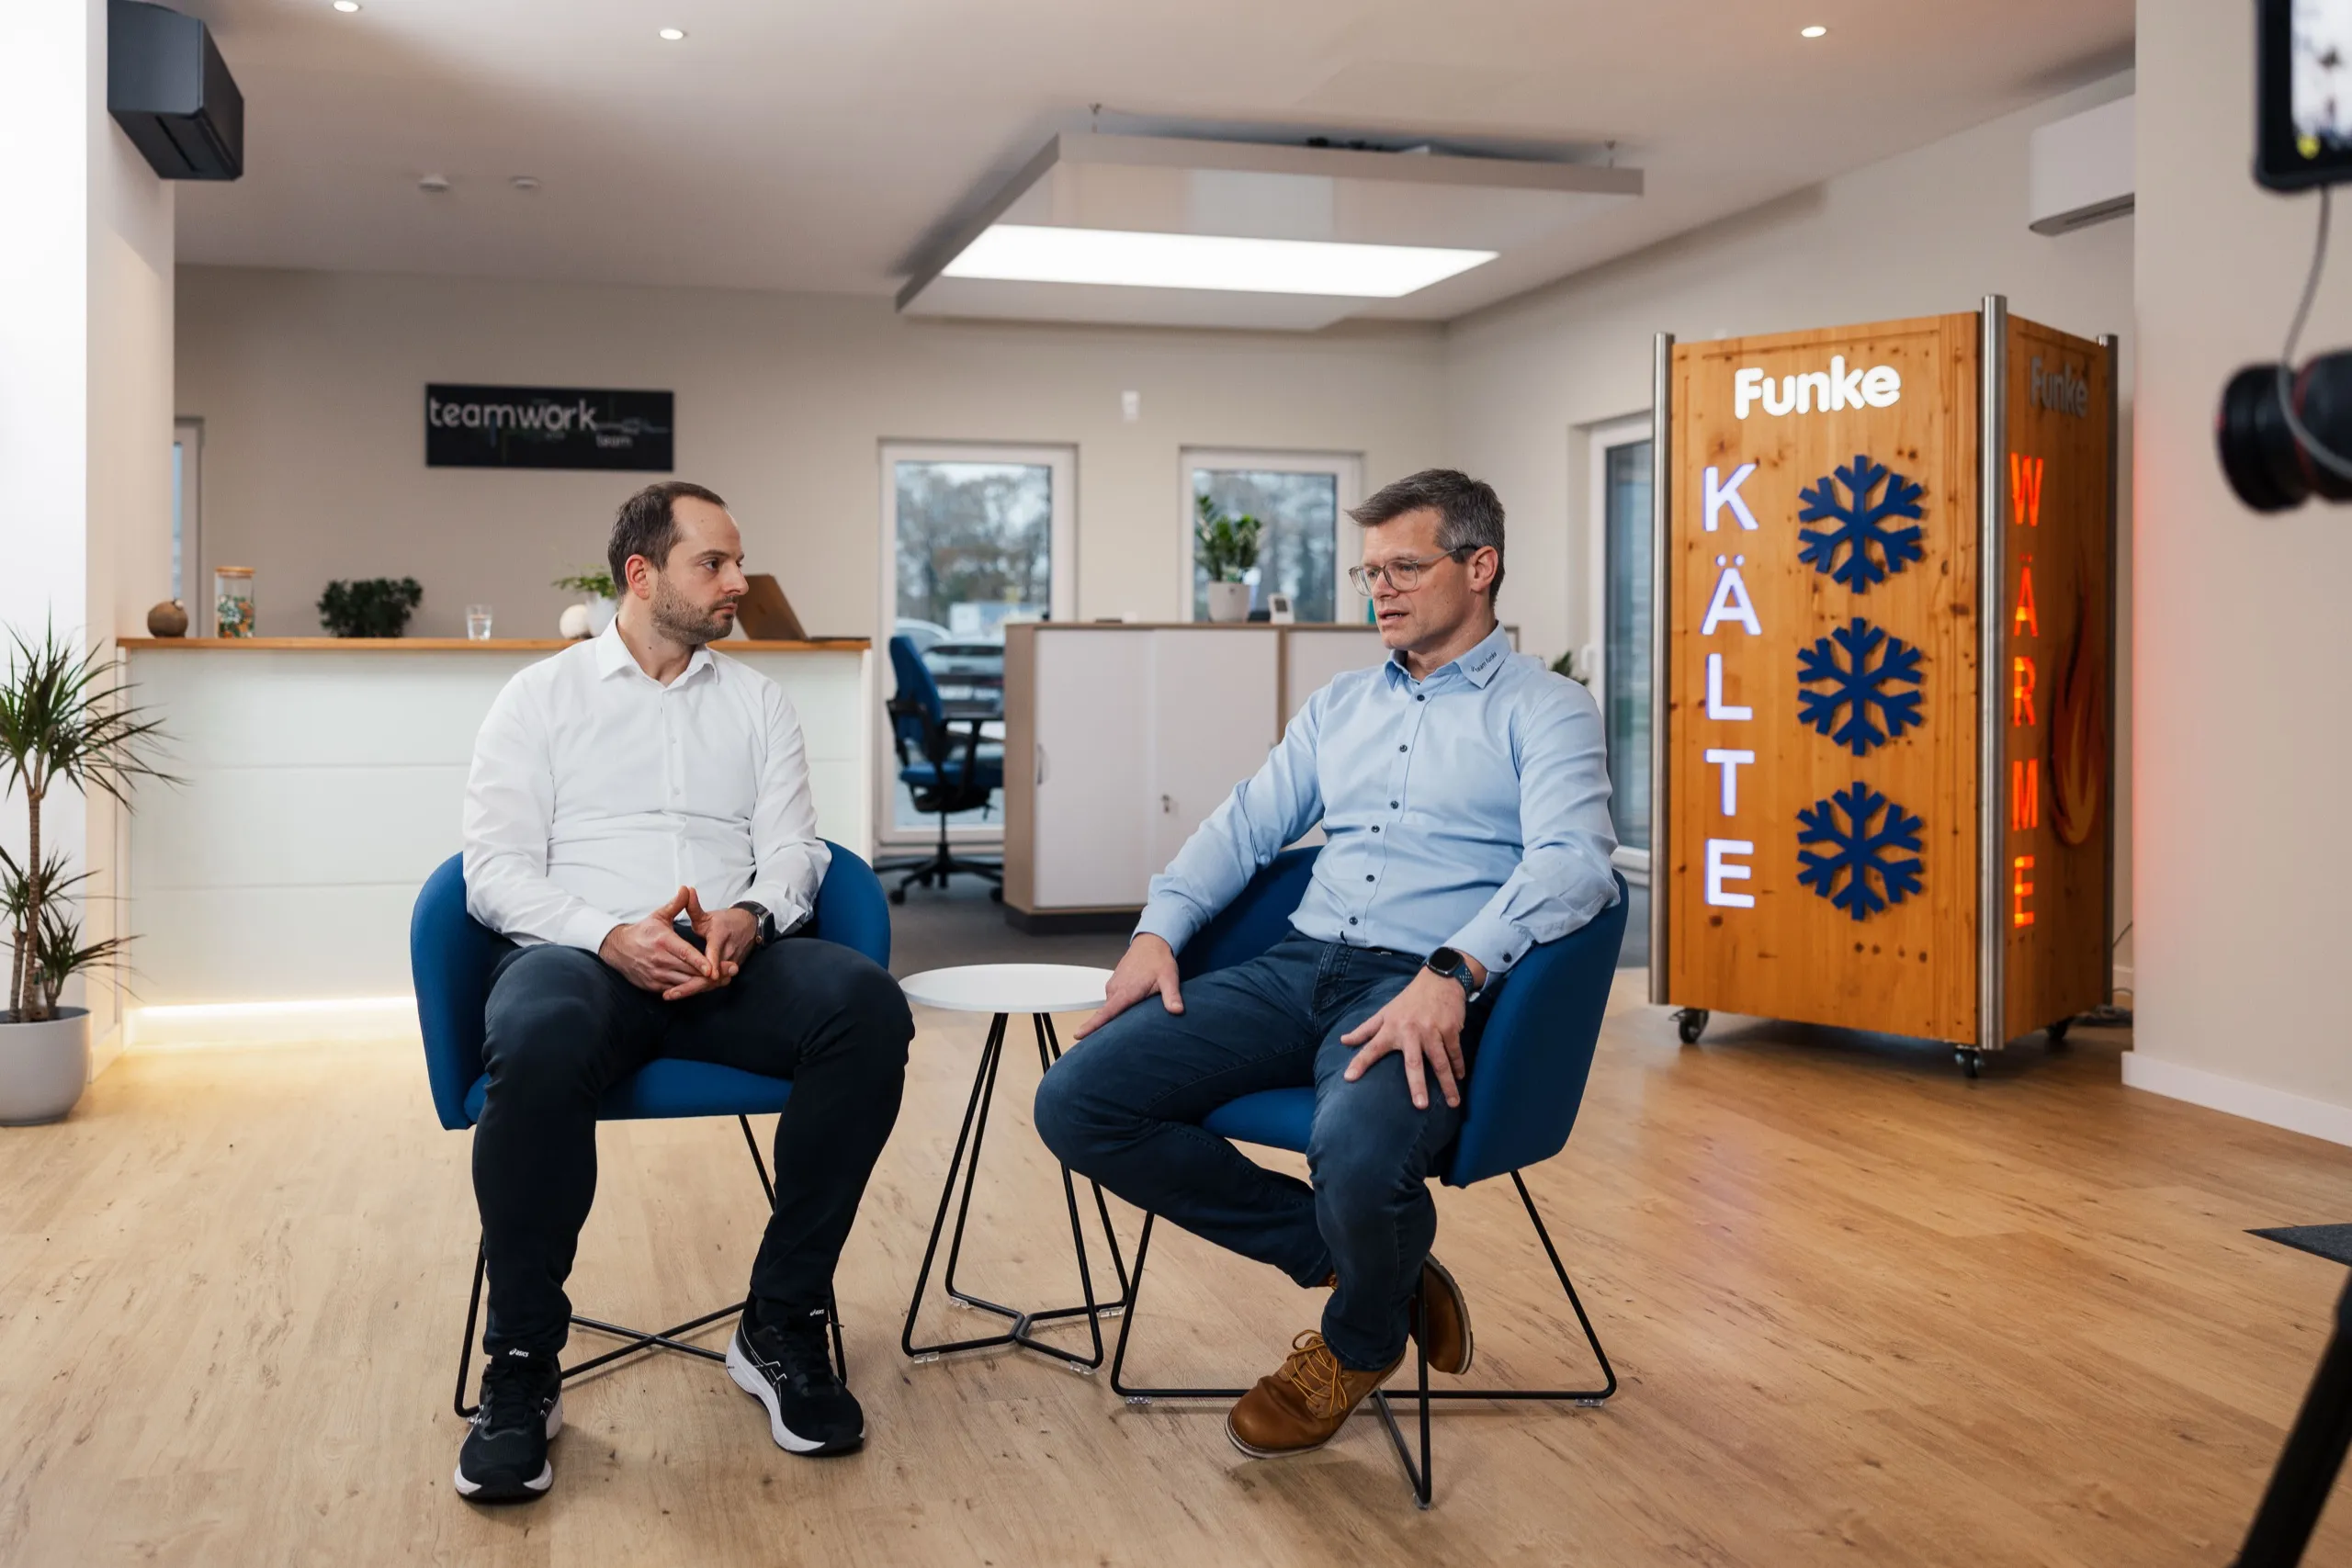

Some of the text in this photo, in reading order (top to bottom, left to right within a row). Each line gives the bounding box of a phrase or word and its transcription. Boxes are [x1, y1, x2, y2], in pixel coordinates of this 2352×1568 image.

[429, 397, 597, 432] teamwork
[1734, 355, 1901, 420] Funke
[2030, 355, 2088, 418] Funke
[1702, 463, 1761, 908] KÄLTE
[2010, 452, 2043, 928] WÄRME
